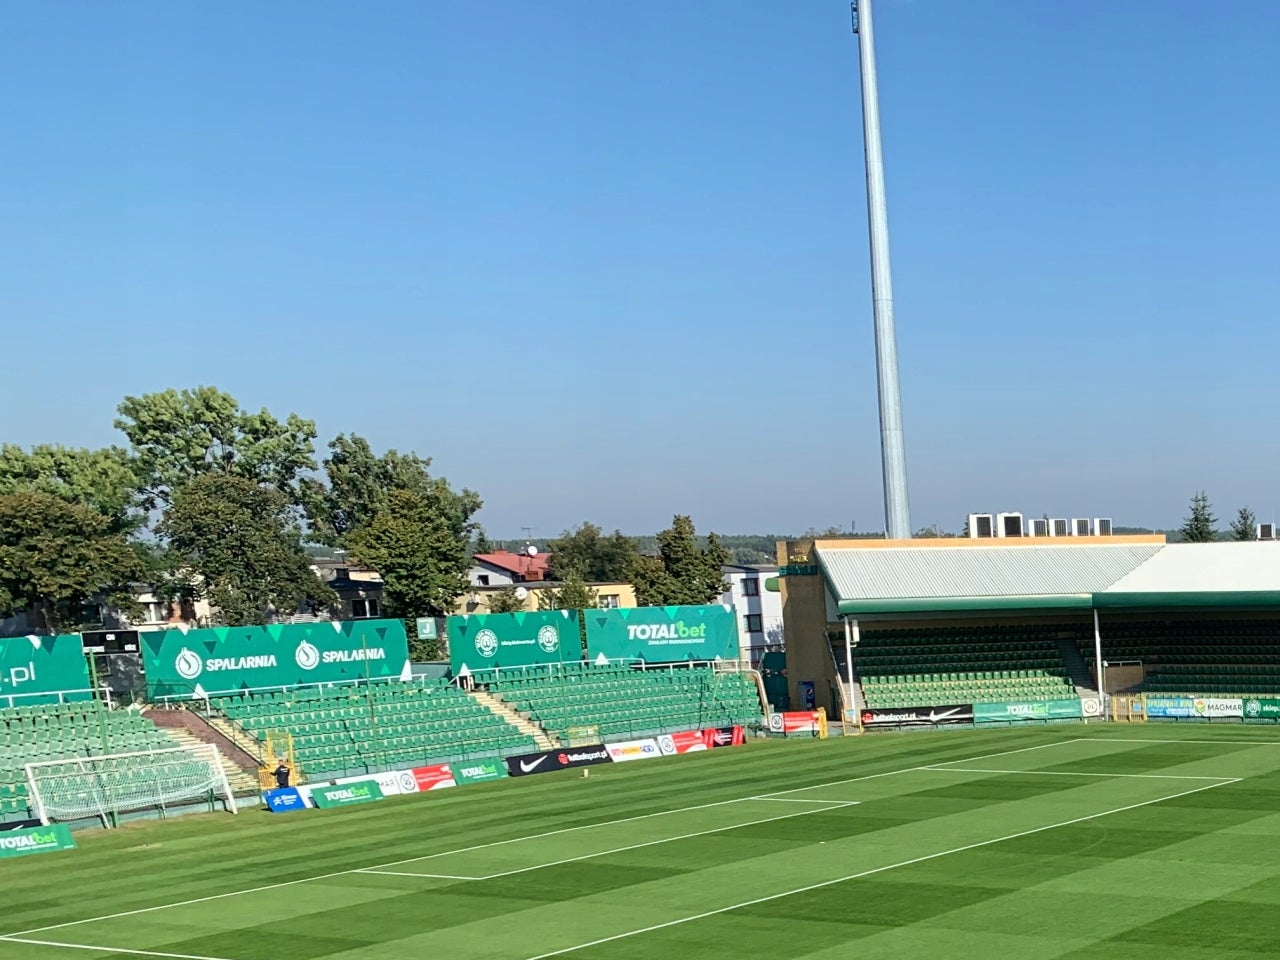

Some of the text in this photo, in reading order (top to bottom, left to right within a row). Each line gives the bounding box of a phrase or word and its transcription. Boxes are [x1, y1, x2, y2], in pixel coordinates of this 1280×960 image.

[627, 620, 706, 640] TOTALbet
[206, 655, 277, 672] SPALARNIA
[322, 648, 385, 663] SPALARNIA
[0, 661, 36, 688] .pl
[1207, 703, 1242, 711] MAGMAR
[324, 786, 370, 801] TOTALbet
